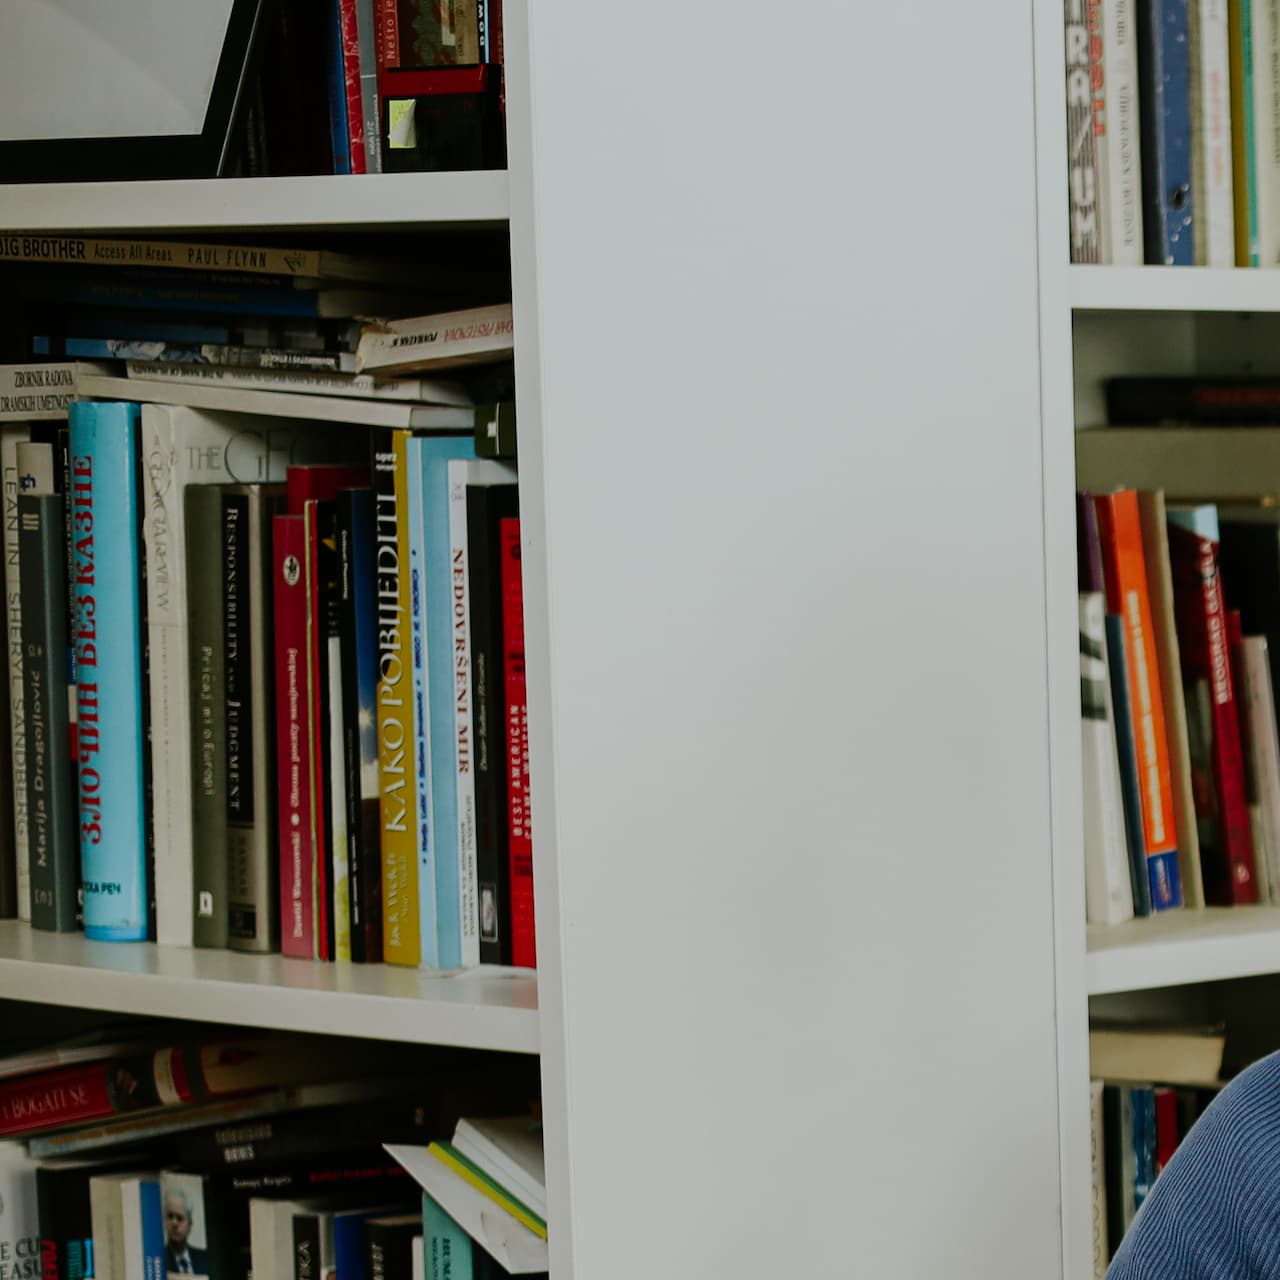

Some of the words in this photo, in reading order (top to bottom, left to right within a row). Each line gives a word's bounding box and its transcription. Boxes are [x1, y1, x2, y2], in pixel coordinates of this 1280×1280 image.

[23, 240, 86, 259] BROTHER
[95, 243, 126, 259] Access
[129, 245, 142, 260] All
[146, 245, 172, 261] Areas
[188, 247, 219, 266] PAUL
[226, 249, 267, 267] FLYNN
[3, 467, 18, 530] LEAN
[71, 455, 97, 587] КАЗНЕ
[6, 539, 21, 566] IN
[225, 506, 241, 663] RESPONSIBILITY
[8, 593, 25, 687] SHERYL
[74, 595, 99, 667] БЕЗ
[375, 492, 405, 705] POBIJEDITI
[451, 548, 470, 714] NEDOVRŠENI
[28, 670, 46, 793] Dragojlović
[78, 683, 102, 844] ЗЛОЧИН
[225, 698, 242, 812] JUDGMENT
[383, 718, 408, 832] KAKO
[455, 724, 471, 775] MIR
[508, 703, 522, 789] AMERICAN
[31, 799, 49, 867] Marija
[510, 796, 523, 837] BEST
[11, 1087, 68, 1120] BOGATI
[70, 1083, 89, 1105] SE
